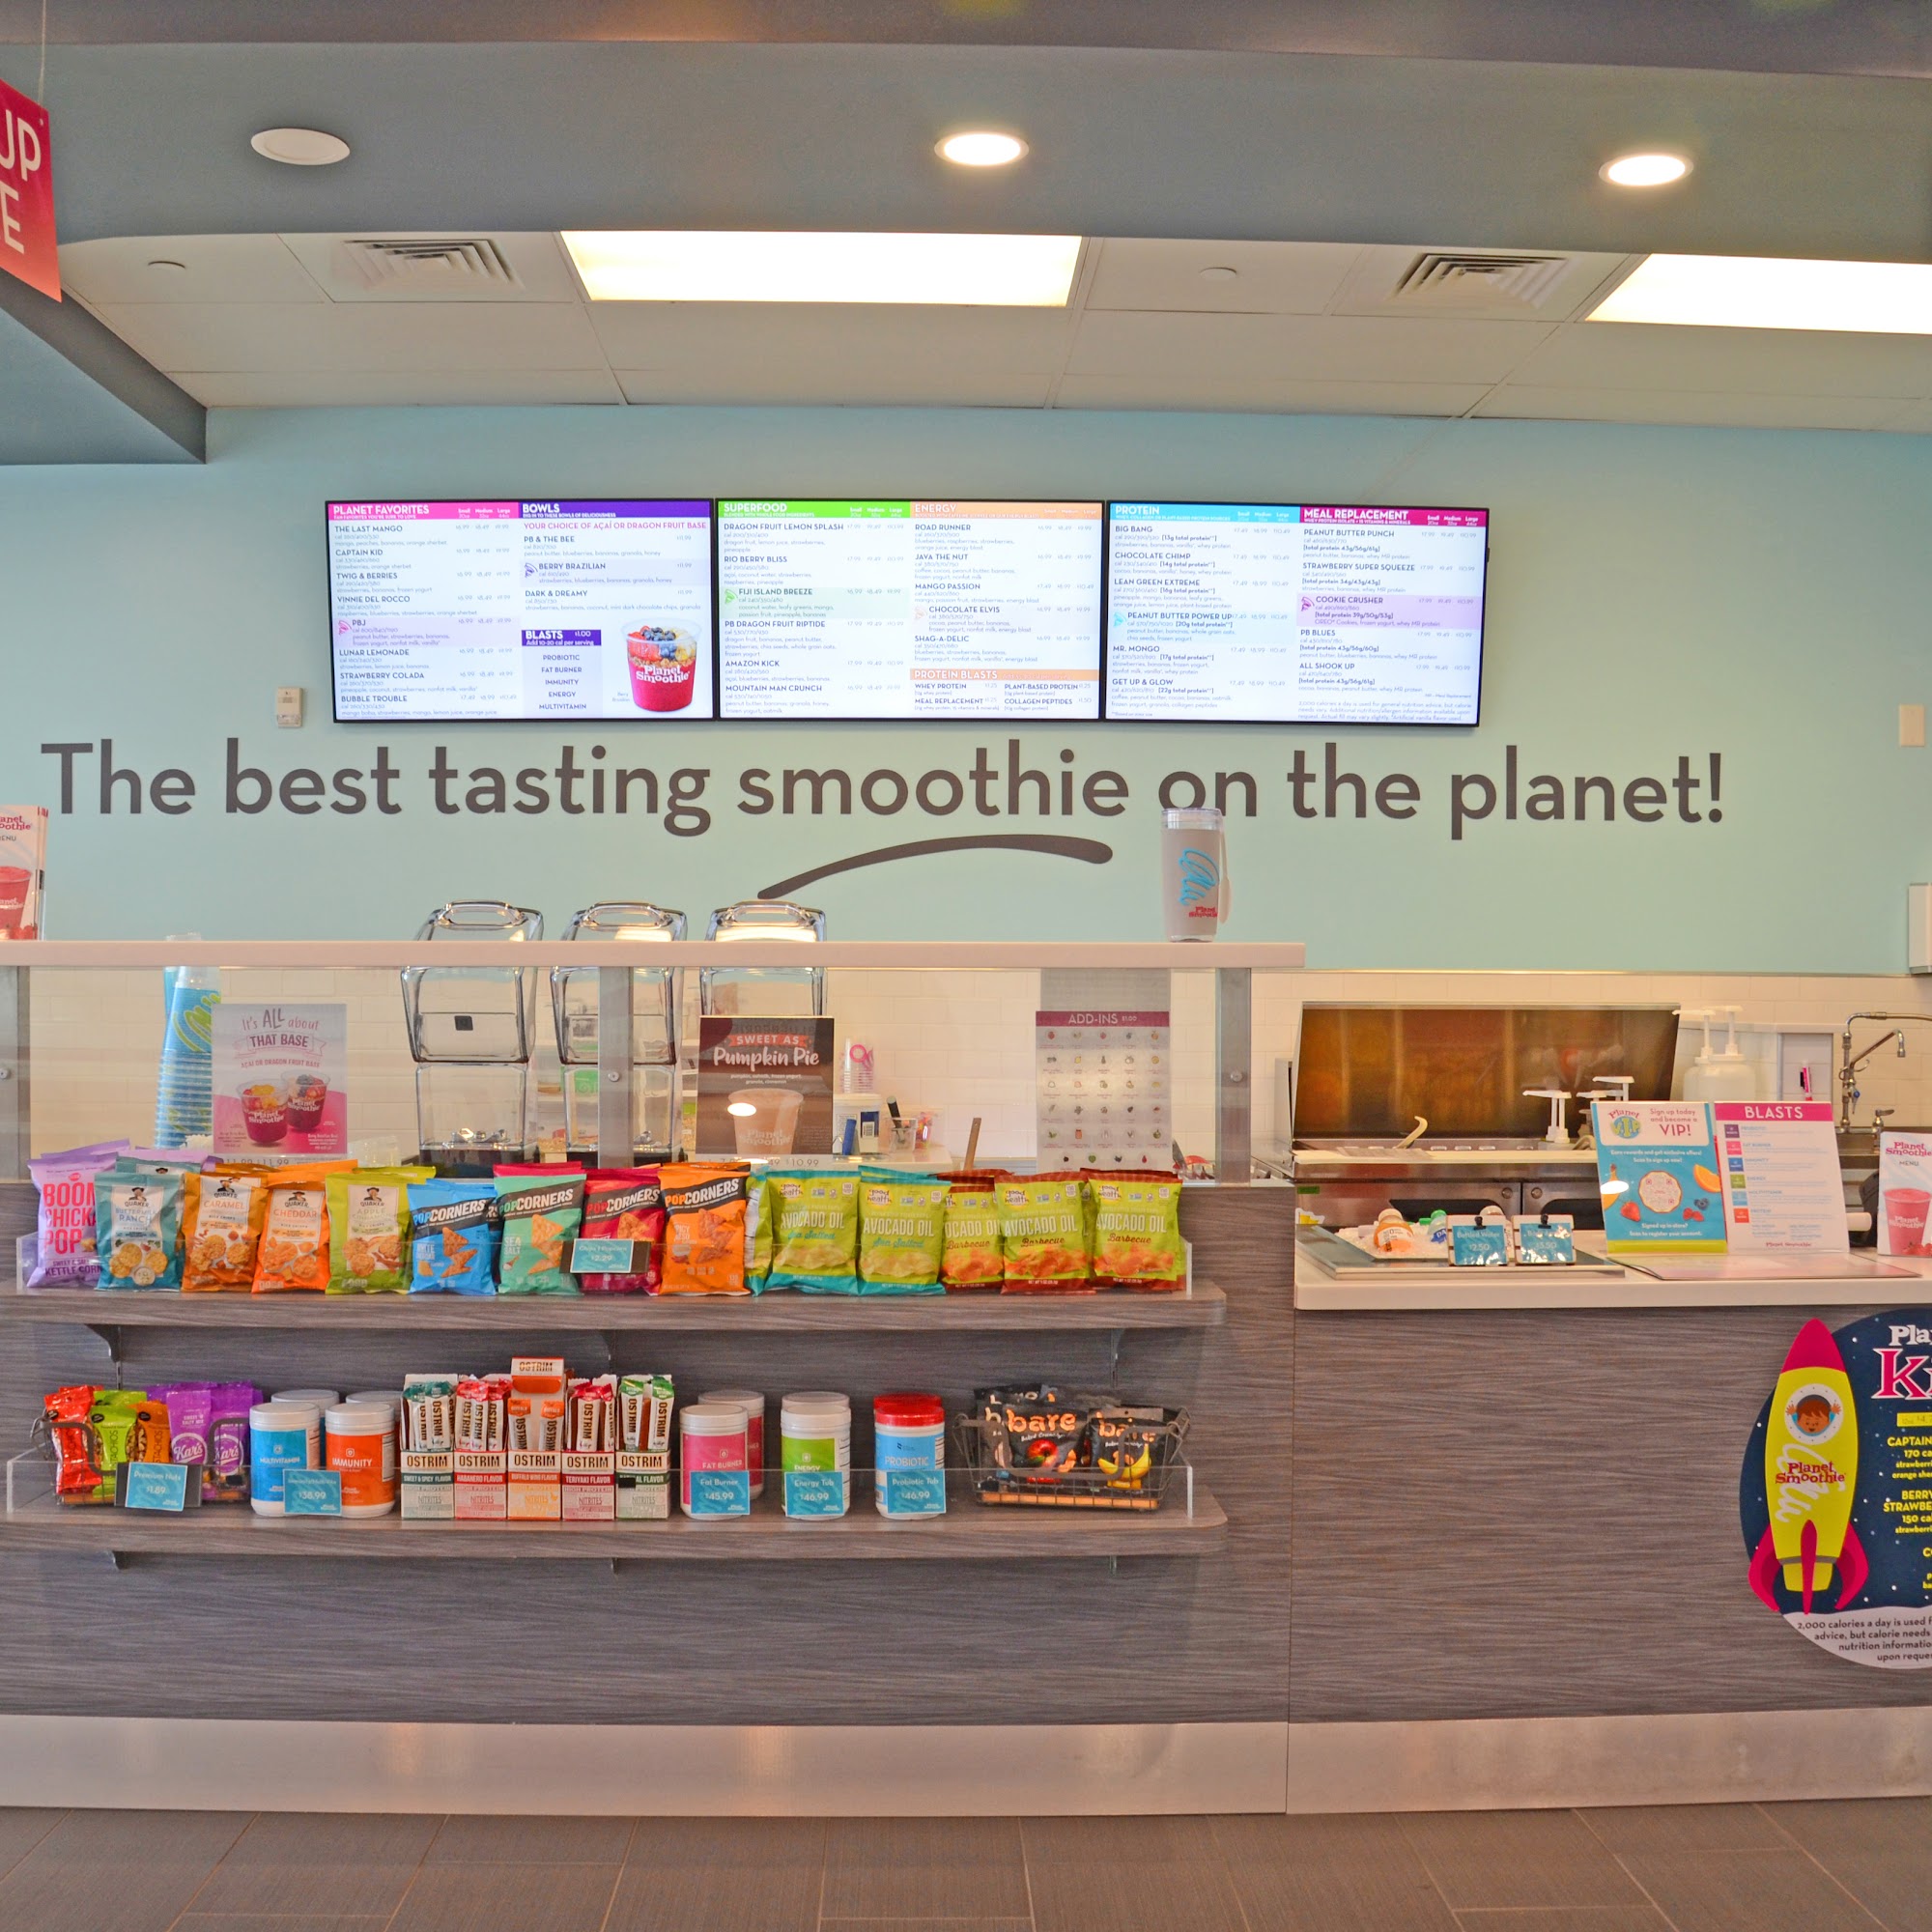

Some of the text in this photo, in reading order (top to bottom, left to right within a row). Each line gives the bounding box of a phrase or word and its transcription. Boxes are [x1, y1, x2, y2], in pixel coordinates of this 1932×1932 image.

[333, 504, 429, 516] PLANET FAVORITES
[523, 503, 560, 514] BOWLS
[724, 502, 787, 513] SUPERFOOD
[915, 503, 956, 513] ENERGY
[1116, 505, 1160, 516] PROTEIN
[1303, 509, 1408, 521] MEAL REPLACEMENT
[525, 630, 563, 640] BLASTS
[636, 665, 690, 684] Planet Smoothie
[914, 670, 961, 679] PROTEIN
[960, 670, 998, 679] BLASTS
[42, 738, 1722, 840] The best tasting smoothie on the planet!
[242, 1008, 320, 1031] It's ALL about
[1067, 1013, 1119, 1025] ADD-INS
[249, 1034, 309, 1047] THAT BASE
[736, 1035, 800, 1045] SWEET AS
[714, 1046, 820, 1072] Pumpkin Pie
[1745, 1106, 1804, 1119] BLASTS
[1659, 1123, 1691, 1136] VIP!
[1893, 1141, 1925, 1151] Planet
[1885, 1148, 1932, 1157] Smoothie
[665, 1178, 739, 1207] POPCORNERS
[204, 1200, 245, 1210] CARAMEL
[499, 1188, 574, 1213] POPCORNERS
[586, 1187, 661, 1215] POPCORNERS
[272, 1208, 318, 1219] CHEDDAR
[413, 1199, 487, 1226] POPCORNERS
[780, 1210, 845, 1230] AVOCADO OIL
[1004, 1214, 1078, 1236] AVOCADO OIL
[1096, 1213, 1167, 1234] AVOCADO OIL
[864, 1217, 934, 1237] AVOCADO OIL
[44, 1228, 83, 1255] POP
[946, 1239, 990, 1250] Barbecue
[1020, 1236, 1065, 1247] Barbecue
[1107, 1234, 1151, 1244] Barbecue
[44, 1266, 77, 1277] KETTLE
[519, 1361, 553, 1373] OSTRIM
[432, 1401, 442, 1436] OSTRIM
[1007, 1409, 1077, 1435] bare
[1887, 1435, 1932, 1447] CAPTAIN
[331, 1457, 373, 1467] IMMUNITY
[407, 1455, 448, 1467] OSTRIM
[459, 1455, 500, 1467] OSTRIM
[514, 1454, 555, 1466] OSTRIM
[567, 1456, 609, 1468] OSTRIM
[621, 1455, 663, 1467] OSTRIM
[884, 1457, 929, 1467] PROBIOTIC
[1788, 1462, 1835, 1475] Planet
[133, 1470, 181, 1481] Premium Nuts
[1775, 1471, 1845, 1485] Smoothie
[700, 1478, 712, 1487] Fat
[794, 1479, 820, 1489] Energy
[1901, 1490, 1932, 1500] BERRY
[1828, 1620, 1865, 1629] calories
[1875, 1618, 1891, 1629] day
[1903, 1616, 1926, 1626] used
[1850, 1631, 1865, 1639] but
[1868, 1630, 1900, 1638] calorie
[1902, 1629, 1930, 1637] needs
[1838, 1642, 1880, 1651] nutrition
